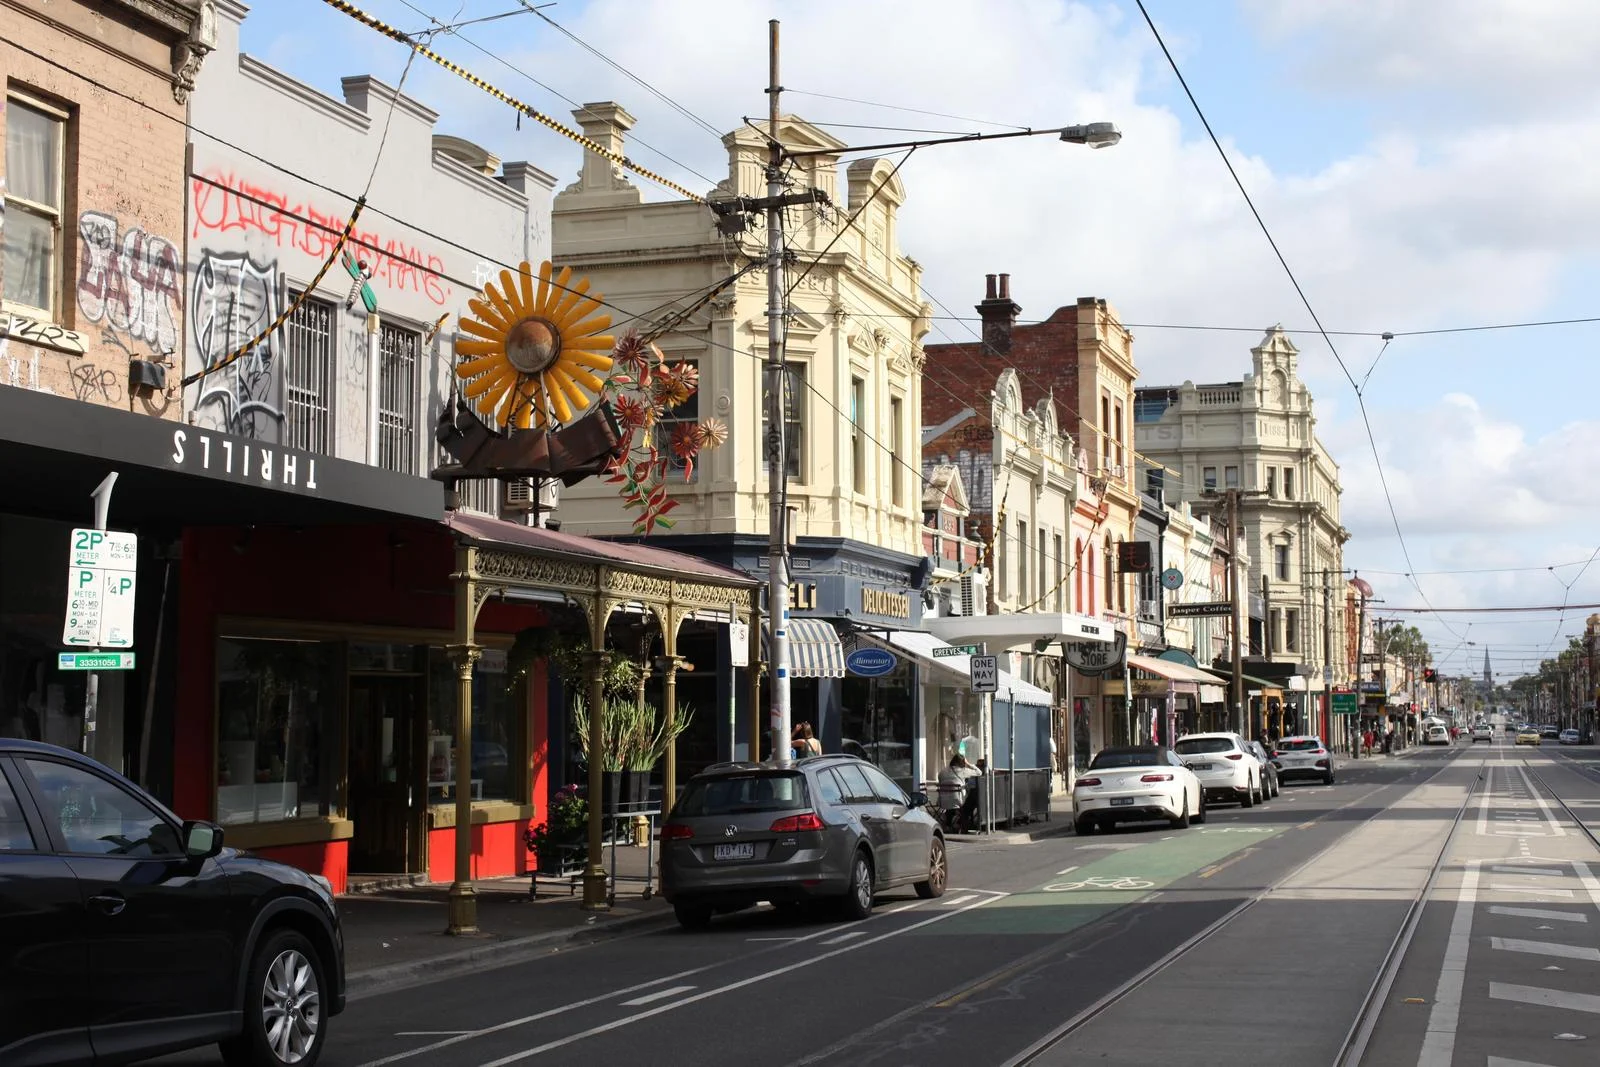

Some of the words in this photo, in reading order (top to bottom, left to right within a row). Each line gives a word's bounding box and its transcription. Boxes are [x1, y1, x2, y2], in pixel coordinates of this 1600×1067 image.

[172, 429, 317, 490] THRILLS
[76, 531, 103, 550] 2P
[76, 552, 99, 560] METER
[80, 571, 93, 588] P
[119, 578, 132, 595] P
[74, 590, 97, 598] METER
[862, 588, 910, 619] DELICATESSEN
[1172, 607, 1200, 615] Jasper
[934, 647, 962, 657] GREEVES
[853, 656, 892, 666] Alimentari
[974, 658, 993, 668] ONE
[974, 670, 994, 680] WAY
